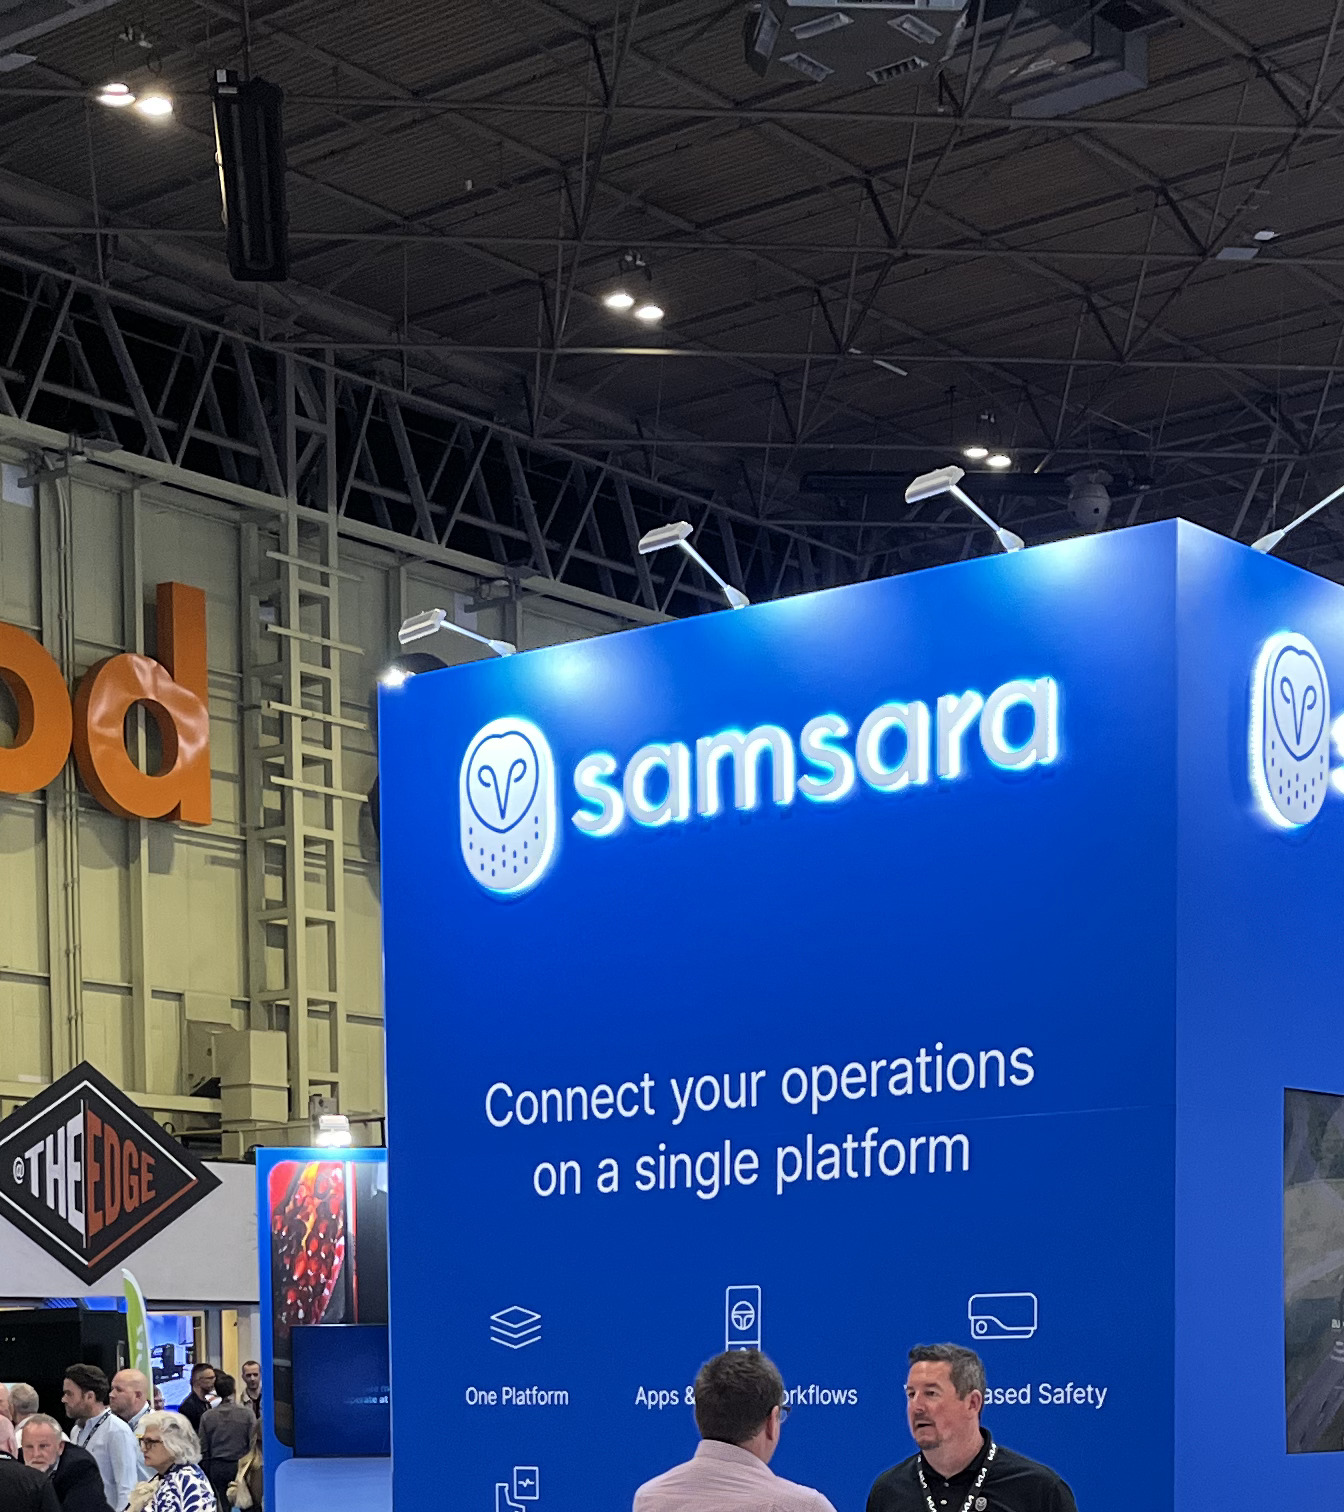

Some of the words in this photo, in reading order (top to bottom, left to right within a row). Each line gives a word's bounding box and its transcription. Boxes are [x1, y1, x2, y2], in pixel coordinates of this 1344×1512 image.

[571, 674, 1060, 837] samsara
[485, 1072, 656, 1128] Connect
[671, 1070, 766, 1126] your
[781, 1041, 1035, 1115] operations
[87, 1109, 156, 1237] EDGE
[533, 1160, 581, 1197] on
[596, 1158, 619, 1194] a
[635, 1139, 759, 1200] single
[776, 1126, 969, 1195] platform
[465, 1386, 497, 1406] One
[502, 1385, 569, 1406] Platform
[635, 1386, 679, 1410] Apps
[782, 1384, 858, 1406] orkflows
[1038, 1382, 1108, 1409] Safety
